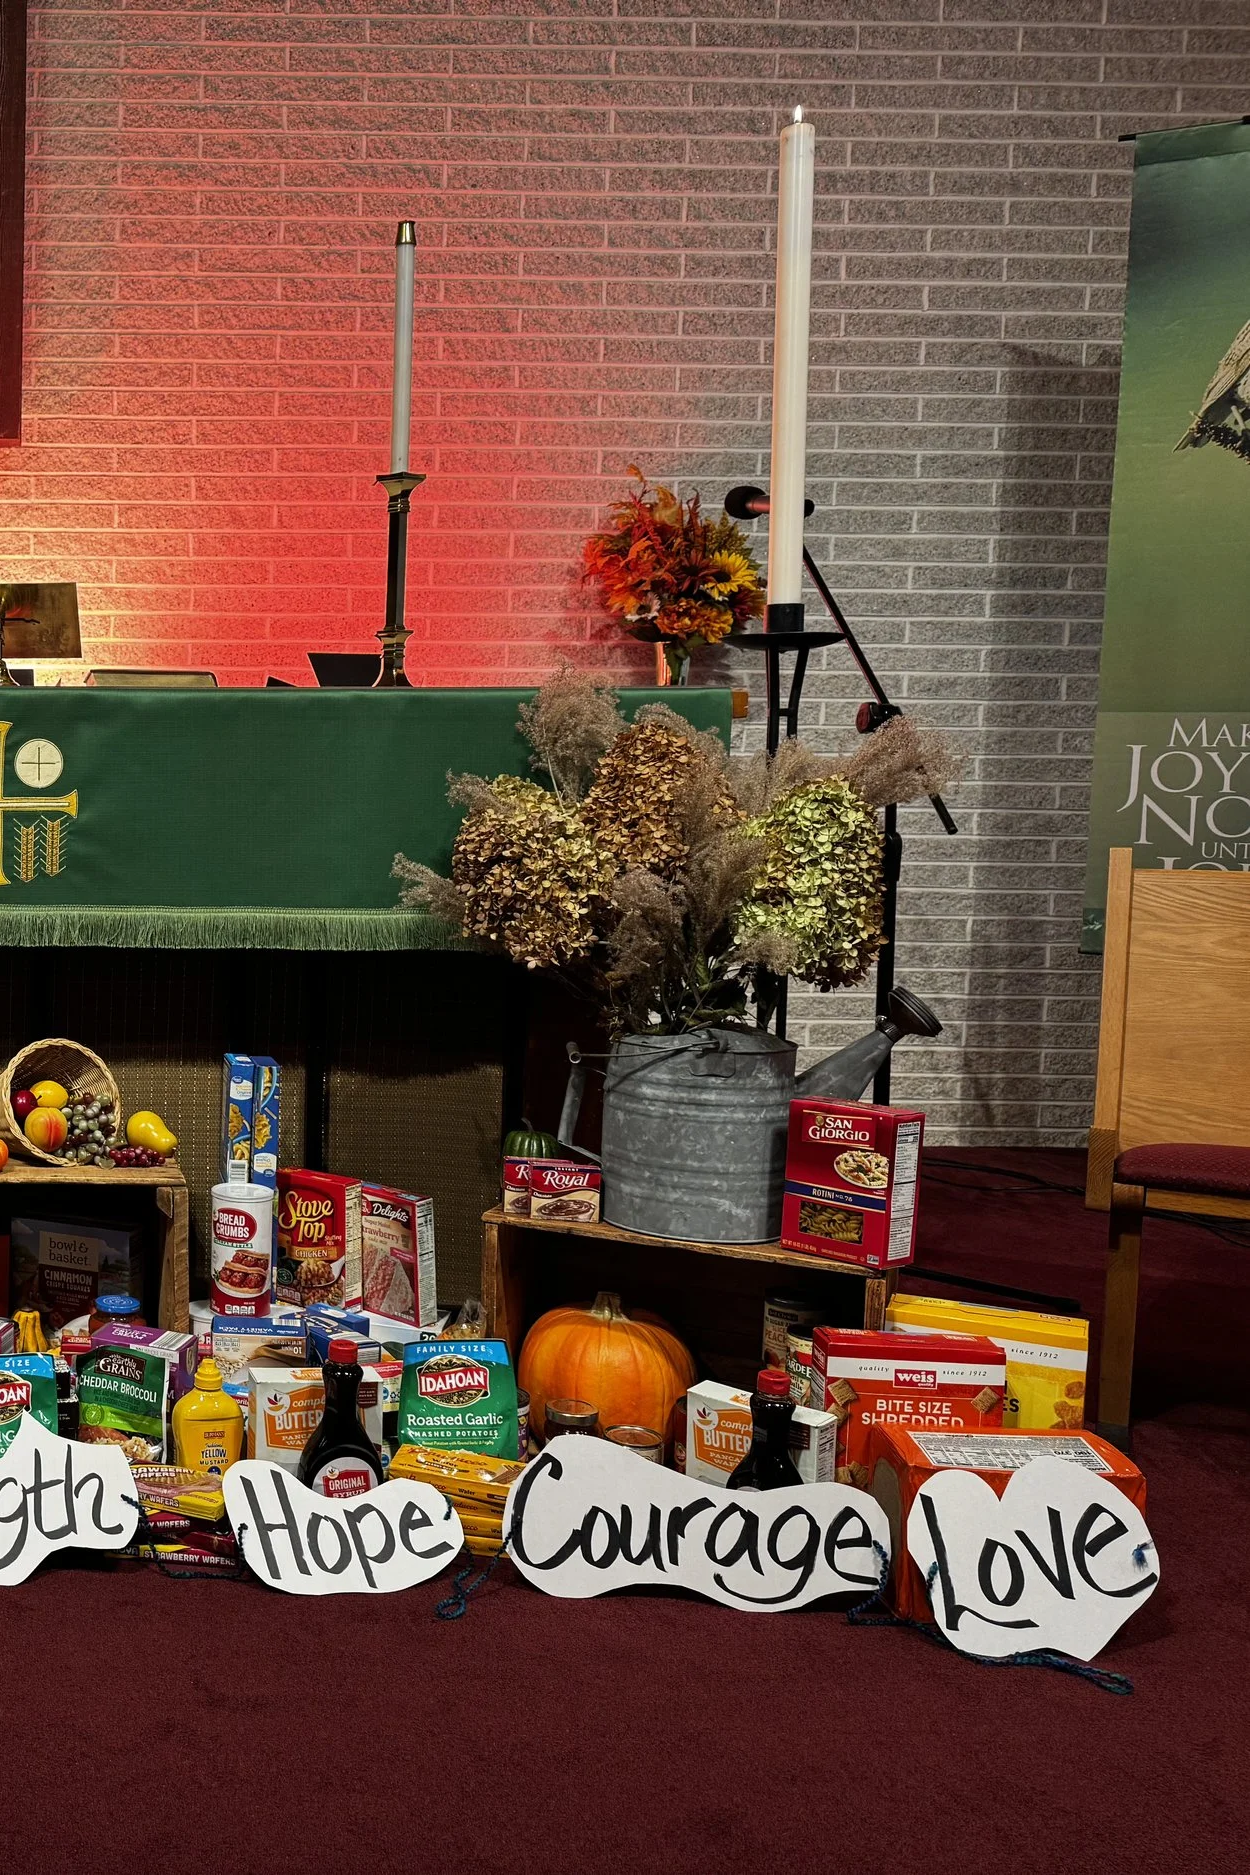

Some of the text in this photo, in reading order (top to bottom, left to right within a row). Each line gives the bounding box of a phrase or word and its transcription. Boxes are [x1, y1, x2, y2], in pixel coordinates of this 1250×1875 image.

[824, 1117, 853, 1129] SAN
[808, 1125, 870, 1142] GIORGIO
[542, 1170, 590, 1190] Royal
[812, 1188, 835, 1200] ROTINI
[278, 1191, 333, 1229] Stove
[372, 1203, 409, 1222] Delights
[219, 1212, 245, 1226] BREAD
[216, 1223, 250, 1239] CRUMBS
[295, 1217, 326, 1243] Top
[49, 1238, 89, 1253] bowl &
[295, 1249, 328, 1258] CHICKEN
[48, 1250, 90, 1266] basket
[44, 1269, 93, 1286] CINNAMON
[416, 1346, 455, 1354] FAMILY
[1011, 1347, 1059, 1359] since 1912
[4, 1359, 30, 1367] SIZE
[99, 1357, 143, 1380] GRAINS
[111, 1357, 137, 1369] earthly
[420, 1371, 486, 1393] IDAHOAN
[858, 1365, 890, 1373] quality
[896, 1371, 935, 1384] weis
[79, 1374, 118, 1392] CHEDDAR
[120, 1382, 157, 1403] BROCCOLI
[876, 1399, 952, 1415] BITE SIZE
[406, 1412, 504, 1426] Roasted Garlic
[456, 1430, 498, 1438] POTATOES
[201, 1449, 227, 1459] YELLOW
[328, 1475, 366, 1491] ORIGINAL
[149, 1495, 179, 1507] WAFERS
[157, 1520, 190, 1528] WAFERS
[240, 1469, 455, 1589] Hope
[512, 1452, 879, 1604] Courage
[202, 1556, 236, 1566] WAFERS
[919, 1493, 1158, 1631] Love
